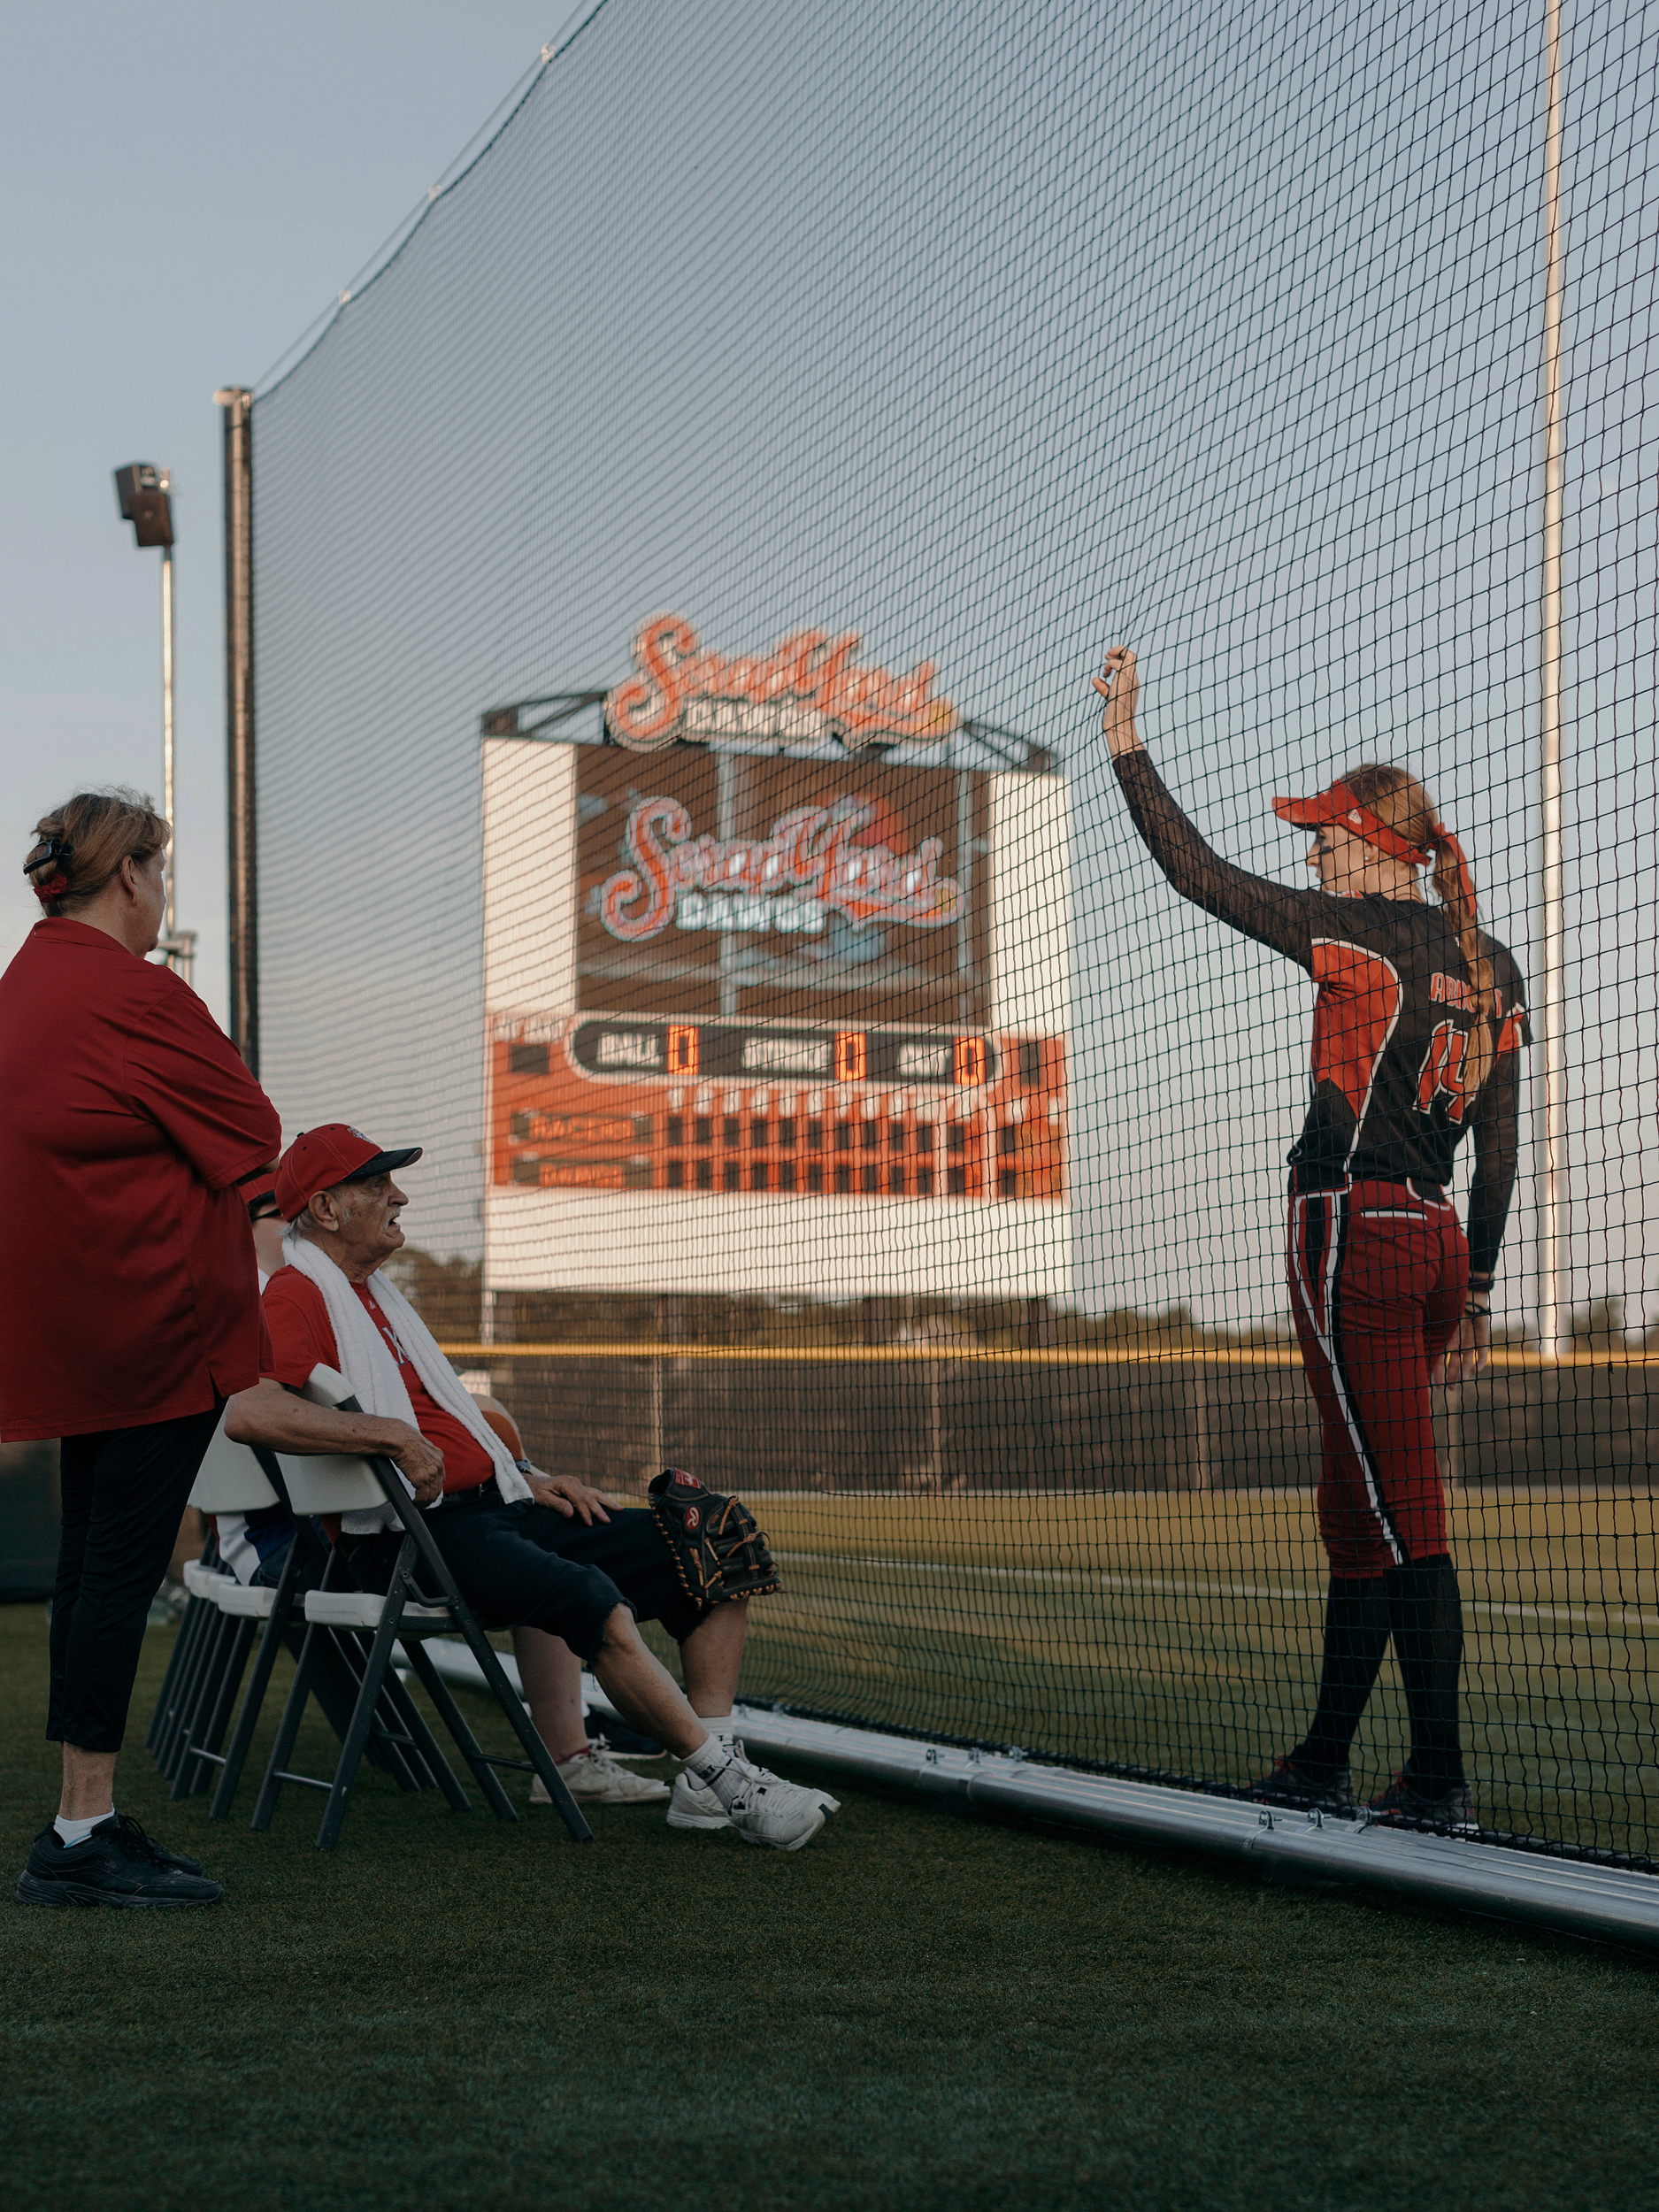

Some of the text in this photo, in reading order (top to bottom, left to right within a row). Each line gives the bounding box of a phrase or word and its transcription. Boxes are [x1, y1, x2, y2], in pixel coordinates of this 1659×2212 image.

[676, 891, 825, 933] DAWGS
[1430, 972, 1502, 1019] ABBOT
[596, 1032, 662, 1067] BALL
[668, 1025, 698, 1075] 0
[835, 1032, 866, 1081] 0
[897, 1042, 952, 1077] OUT
[954, 1036, 985, 1085] 0
